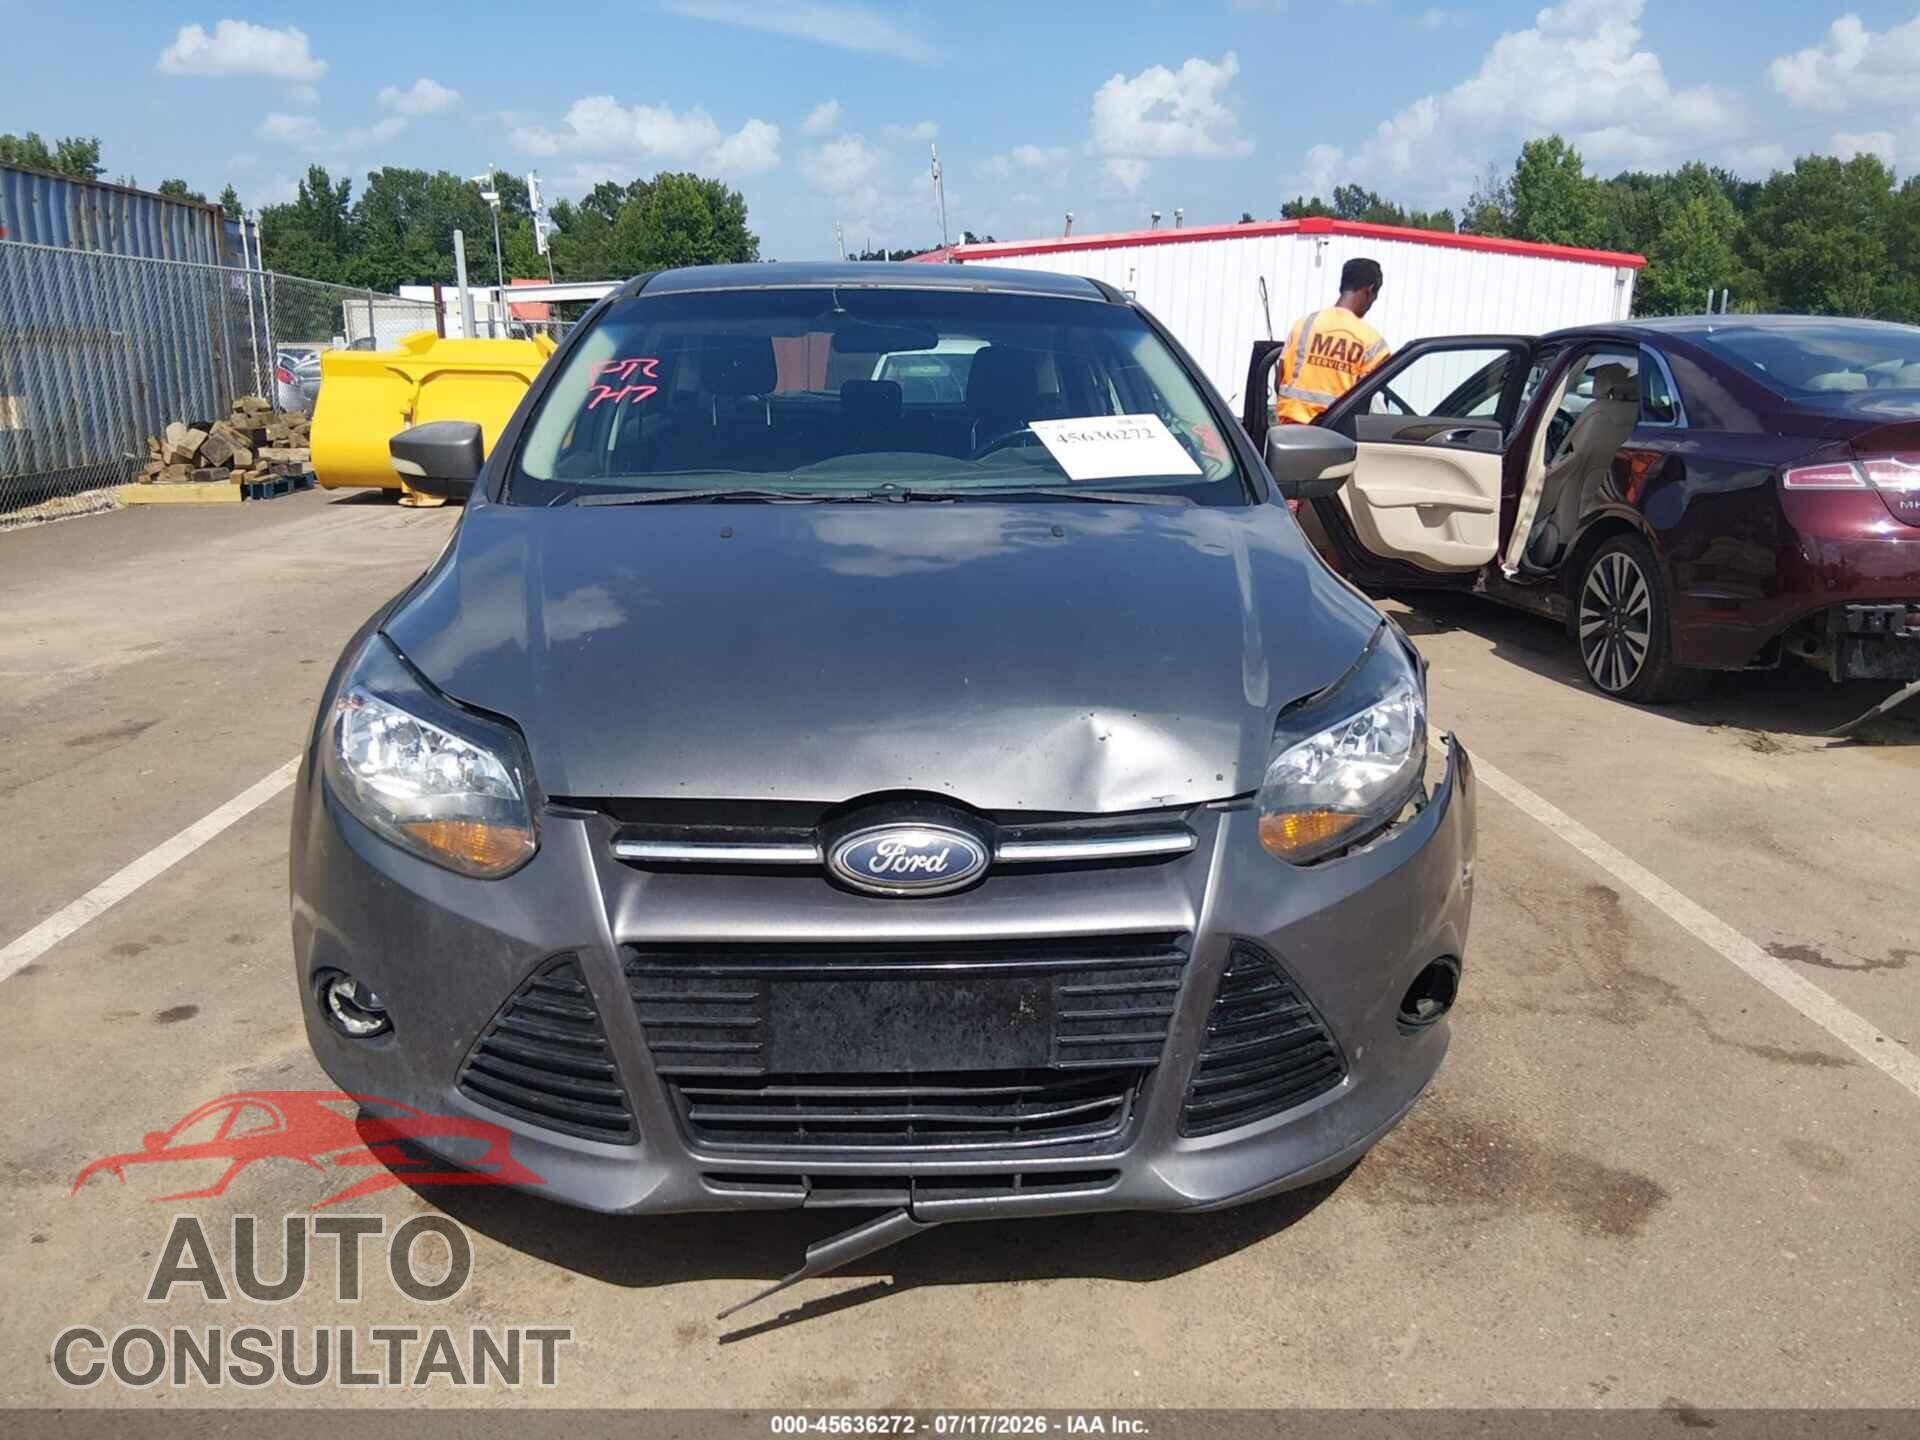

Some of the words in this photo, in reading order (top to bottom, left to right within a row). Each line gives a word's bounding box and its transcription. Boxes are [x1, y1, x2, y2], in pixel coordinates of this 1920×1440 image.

[1310, 333, 1364, 364] MAD
[1055, 427, 1158, 444] 45636272
[869, 836, 949, 873] Ford
